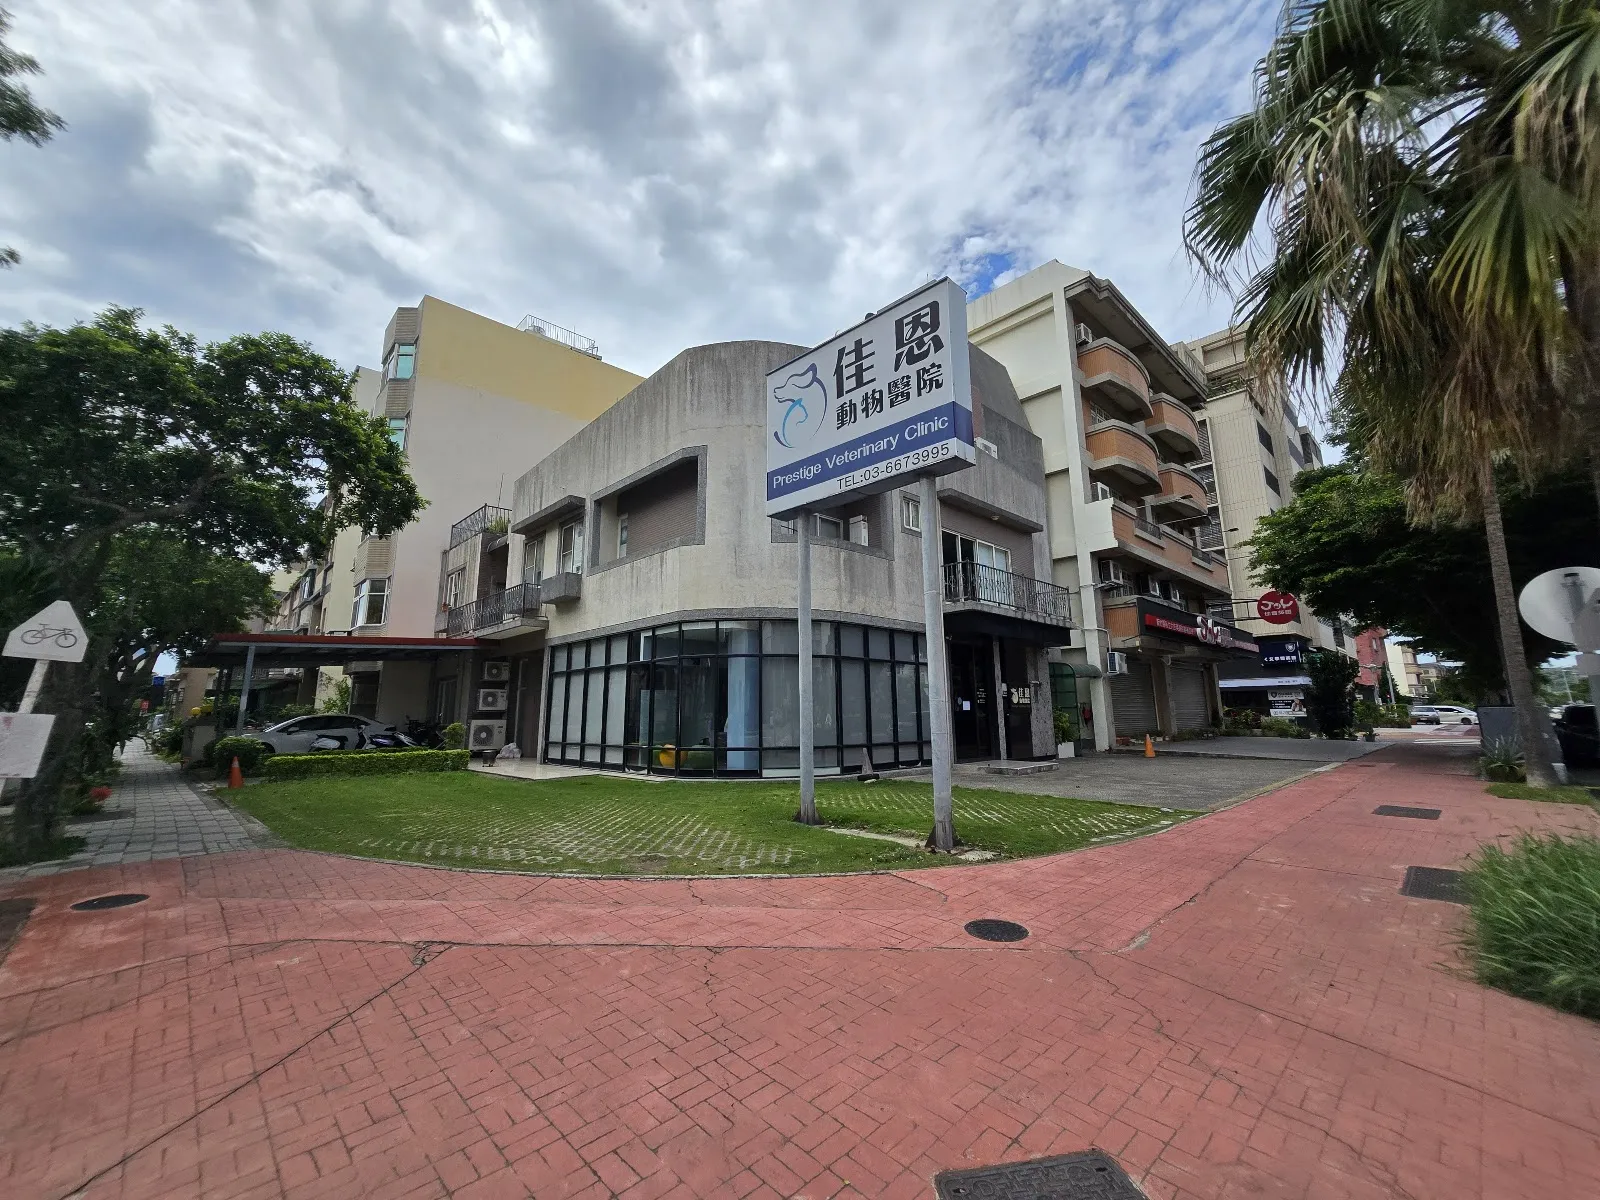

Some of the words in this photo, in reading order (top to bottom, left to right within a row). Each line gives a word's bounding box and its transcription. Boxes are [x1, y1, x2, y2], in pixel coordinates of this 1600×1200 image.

[833, 301, 945, 400] 佳恩
[836, 362, 944, 431] 動物醫院
[773, 463, 822, 489] Prestige
[825, 433, 900, 469] Veterinary
[904, 416, 949, 441] Clinic
[837, 442, 950, 490] TEL:03-6673995
